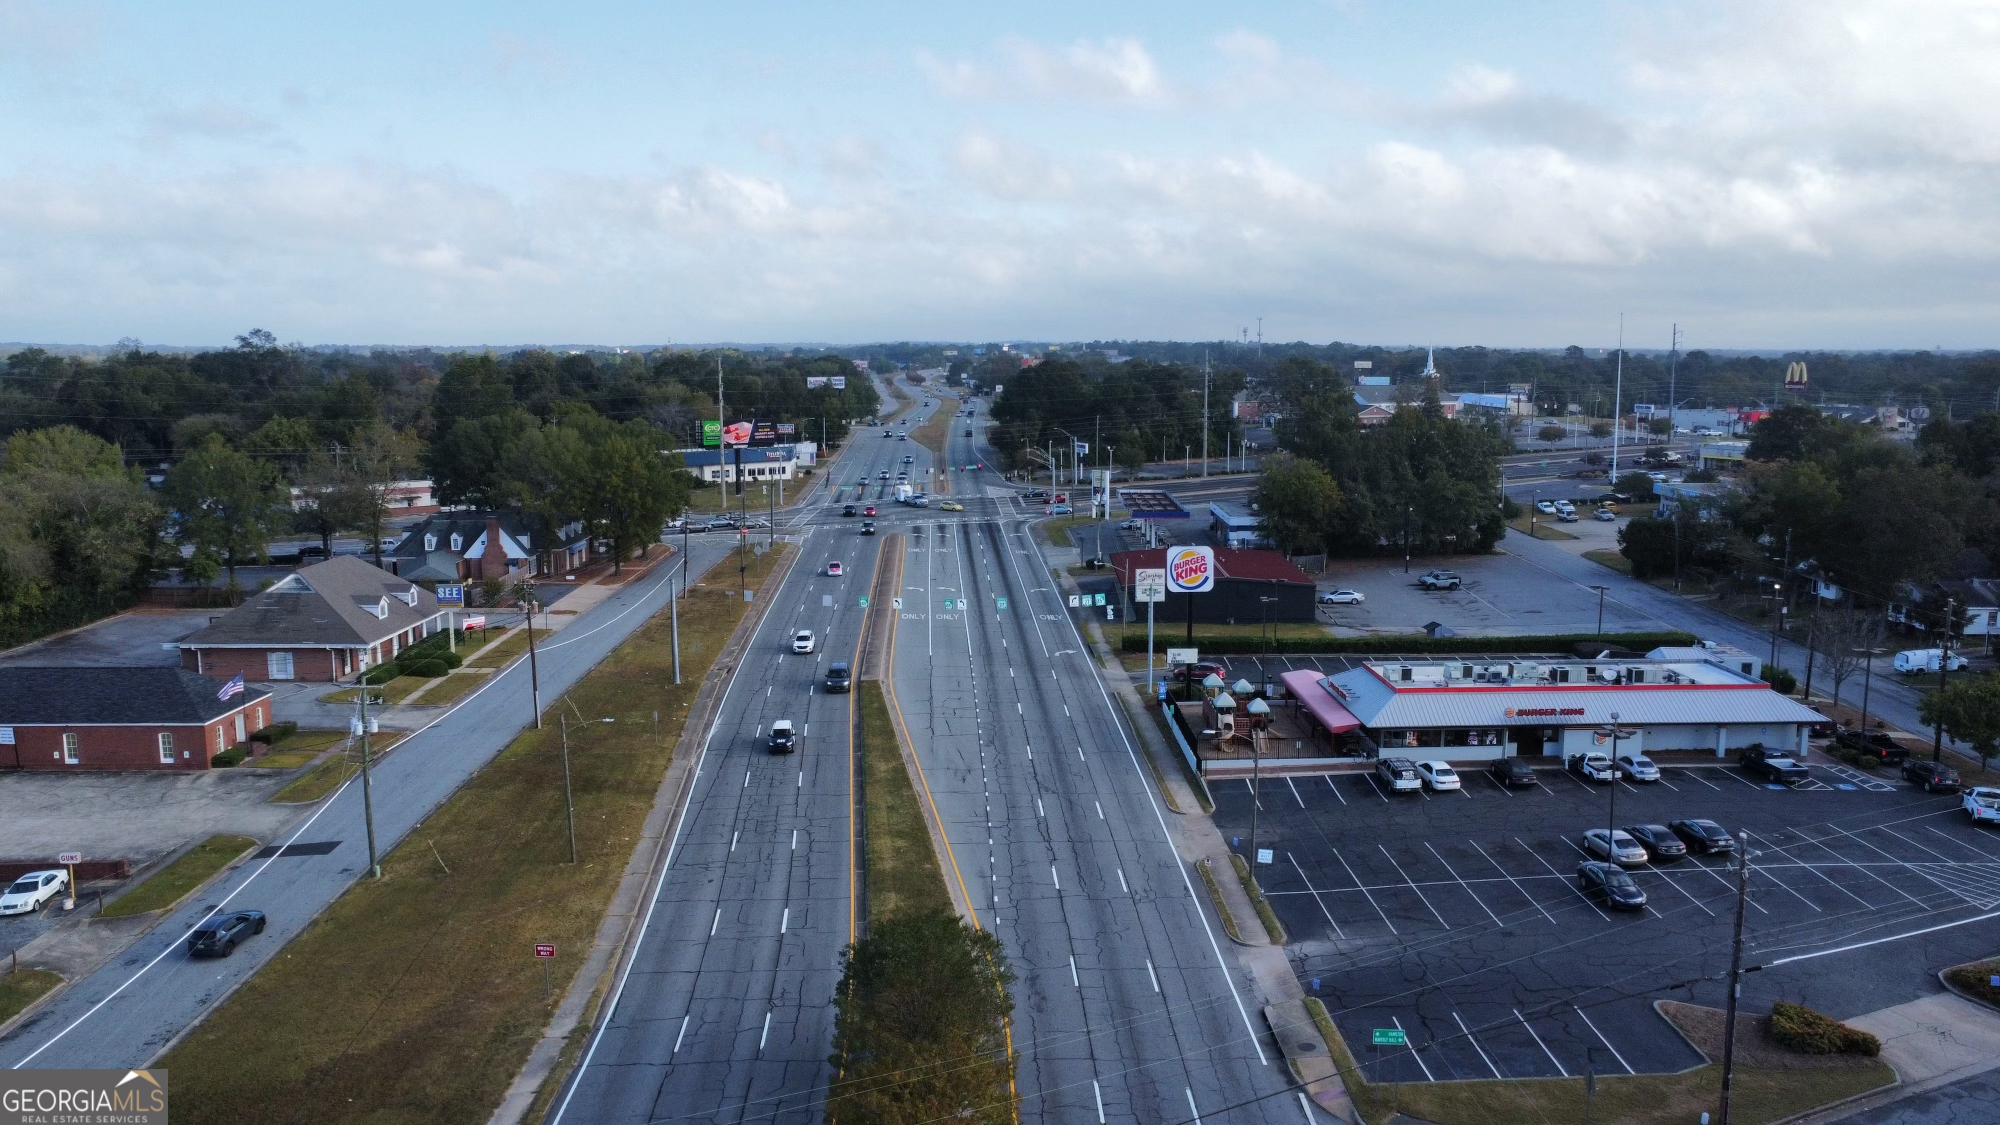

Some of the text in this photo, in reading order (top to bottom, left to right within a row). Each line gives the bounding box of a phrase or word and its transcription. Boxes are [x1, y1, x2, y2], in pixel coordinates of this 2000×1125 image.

[1174, 555, 1206, 572] BURGER
[1175, 562, 1208, 583] KING
[1517, 708, 1557, 717] BURGER
[1559, 707, 1585, 716] KING
